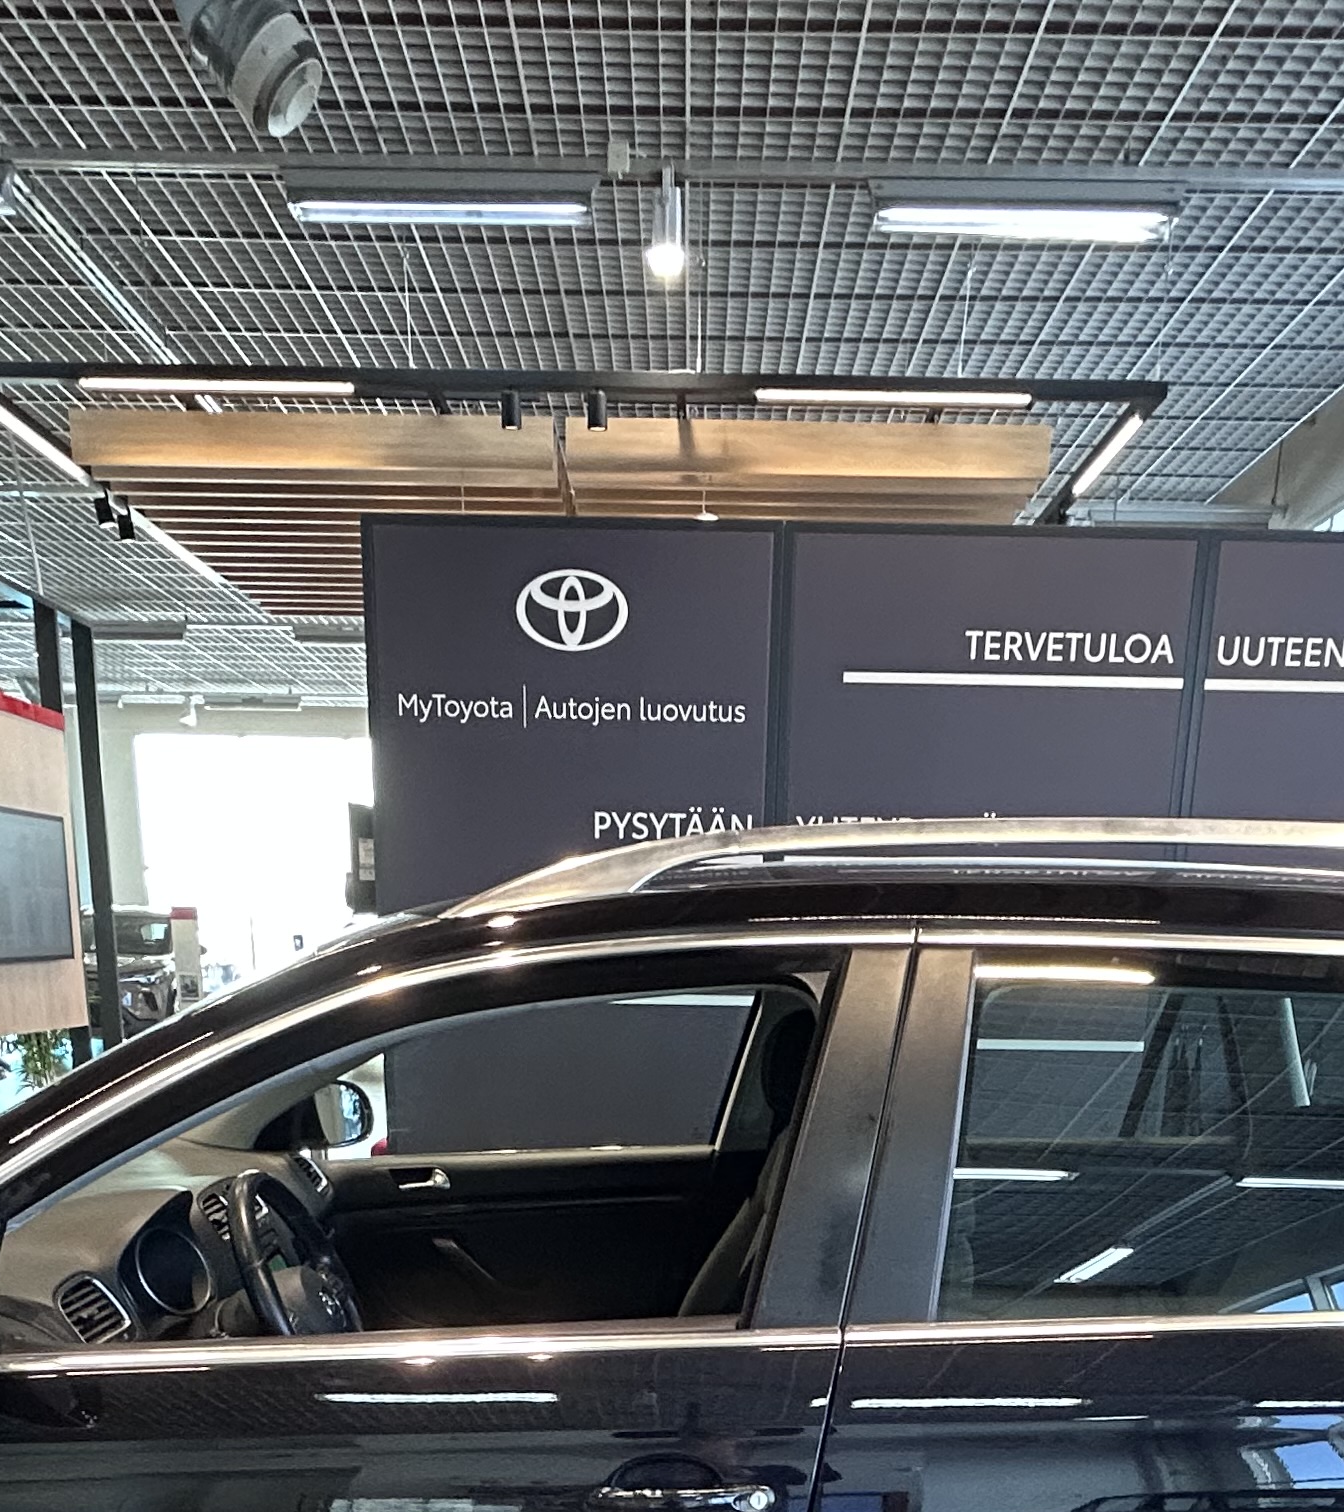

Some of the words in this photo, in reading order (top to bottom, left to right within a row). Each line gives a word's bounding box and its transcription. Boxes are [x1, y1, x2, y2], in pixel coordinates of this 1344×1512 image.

[964, 630, 1175, 664] TERVETULOA
[397, 693, 514, 724] MyToyota
[534, 695, 632, 727] Autojen
[639, 696, 747, 724] luovutus
